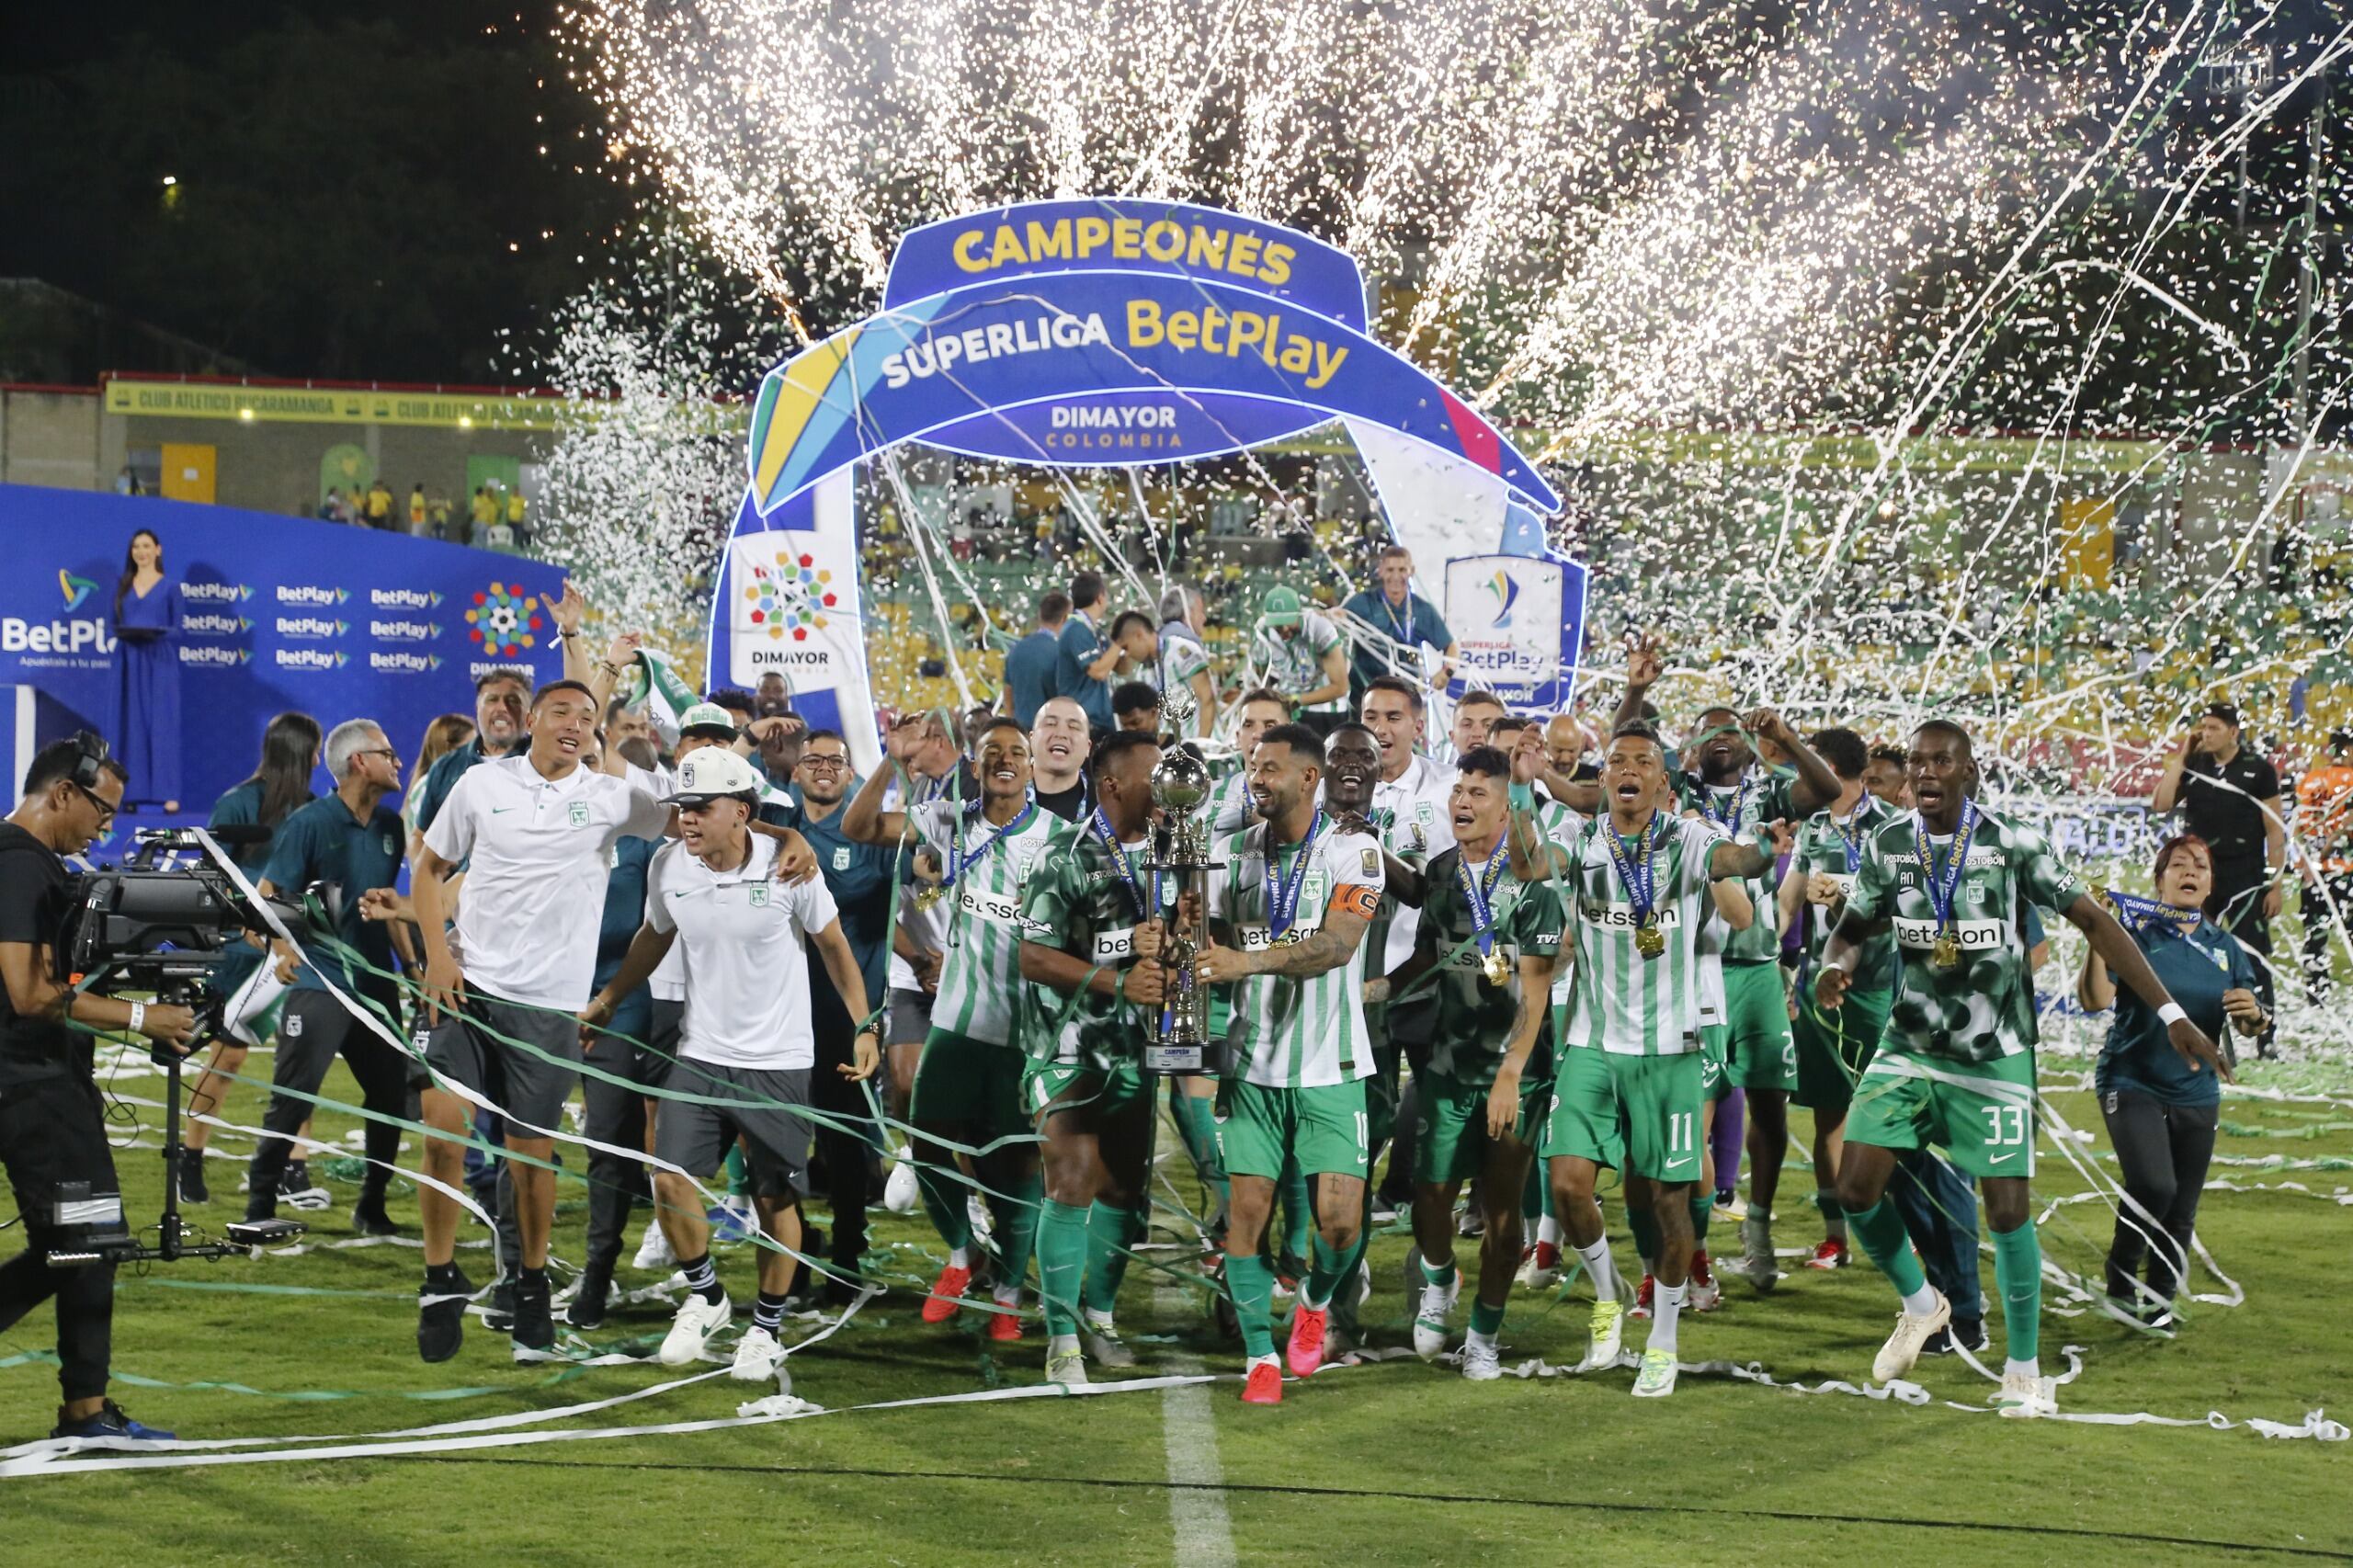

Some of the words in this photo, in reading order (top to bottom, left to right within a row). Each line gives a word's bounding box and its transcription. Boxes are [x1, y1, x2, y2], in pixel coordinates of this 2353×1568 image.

[952, 216, 1297, 286] CAMPEONES
[881, 312, 1108, 389] SUPERLIGA
[1126, 300, 1349, 390] BetPlay
[140, 390, 172, 408] CLUB
[1051, 405, 1176, 430] DIMAYOR
[1046, 432, 1183, 449] COLOMBIA
[180, 583, 239, 603] BetPlay
[277, 585, 335, 606] BetPlay
[371, 589, 429, 608] BetPlay
[2, 618, 119, 653] BetPl
[277, 618, 335, 637] BetPlay
[370, 620, 428, 640] BetPlay
[179, 646, 238, 666] BetPlay
[276, 649, 335, 669] BetPlay
[370, 653, 428, 672] BetPlay
[752, 652, 828, 665] DIMAYOR
[1638, 824, 1653, 867] BetPlay
[1949, 822, 1971, 867] BetPlay
[1106, 835, 1131, 878] BetPlay
[1484, 841, 1508, 886] BetPlay
[1965, 851, 2006, 866] OSTOBÓN
[1620, 858, 1643, 907] SUPERLIGA
[2057, 871, 2076, 893] TVS
[205, 895, 211, 906] 9
[1281, 869, 1304, 919] SUPERLIGA
[1468, 889, 1486, 931] UPERLIGA
[1536, 934, 1559, 945] TVS
[1669, 1112, 1692, 1152] 11
[1981, 1106, 2024, 1145] 33
